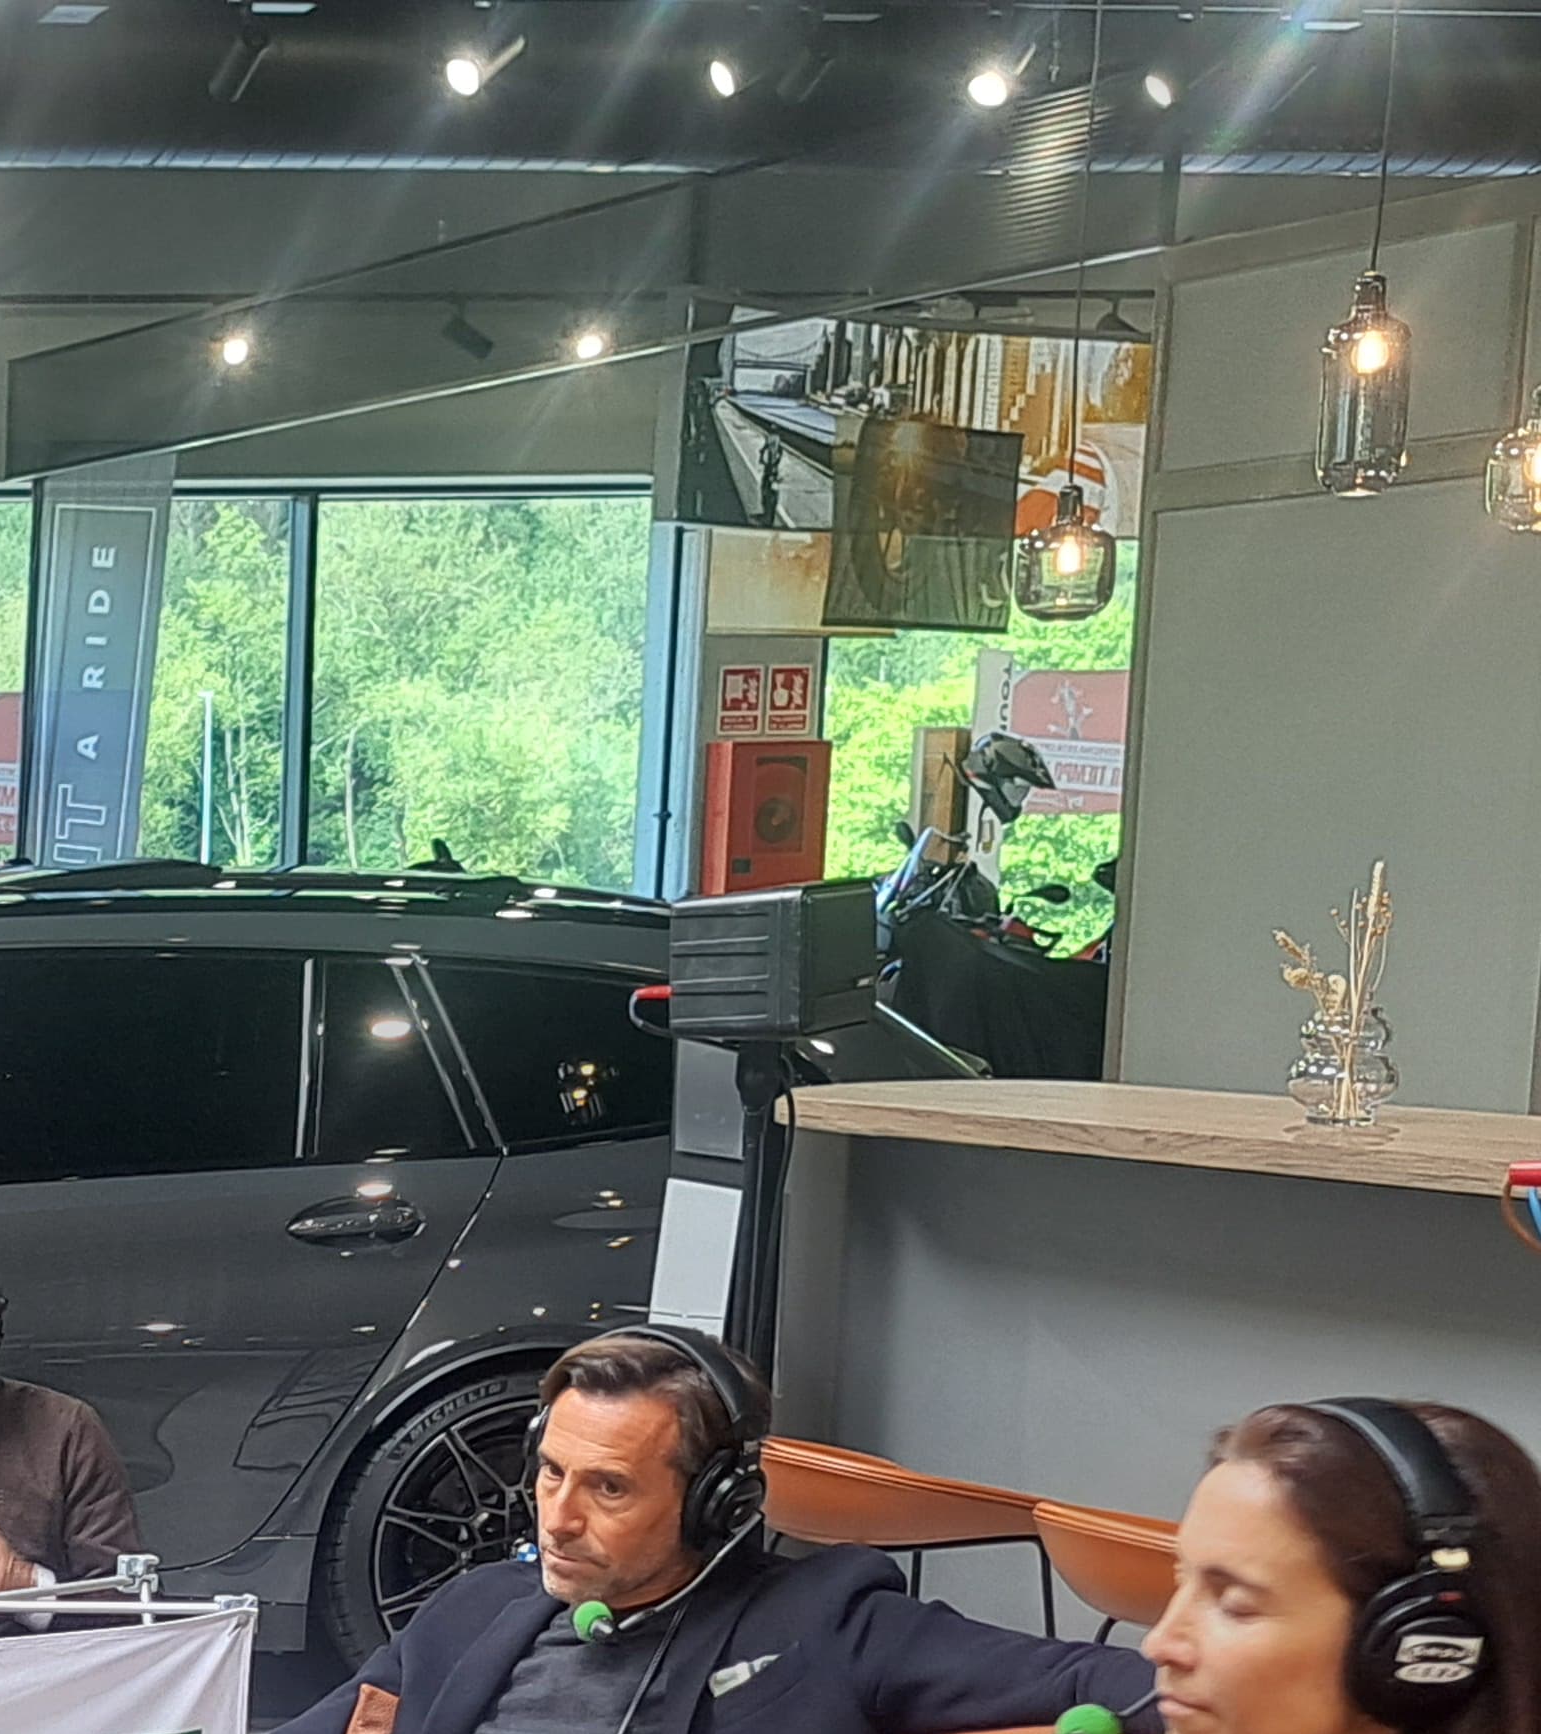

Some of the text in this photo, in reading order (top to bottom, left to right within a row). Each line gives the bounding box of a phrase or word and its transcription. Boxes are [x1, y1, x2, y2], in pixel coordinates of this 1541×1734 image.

[82, 546, 116, 690] RIDE
[77, 735, 100, 760] A
[407, 1382, 502, 1442] MICHELIN
